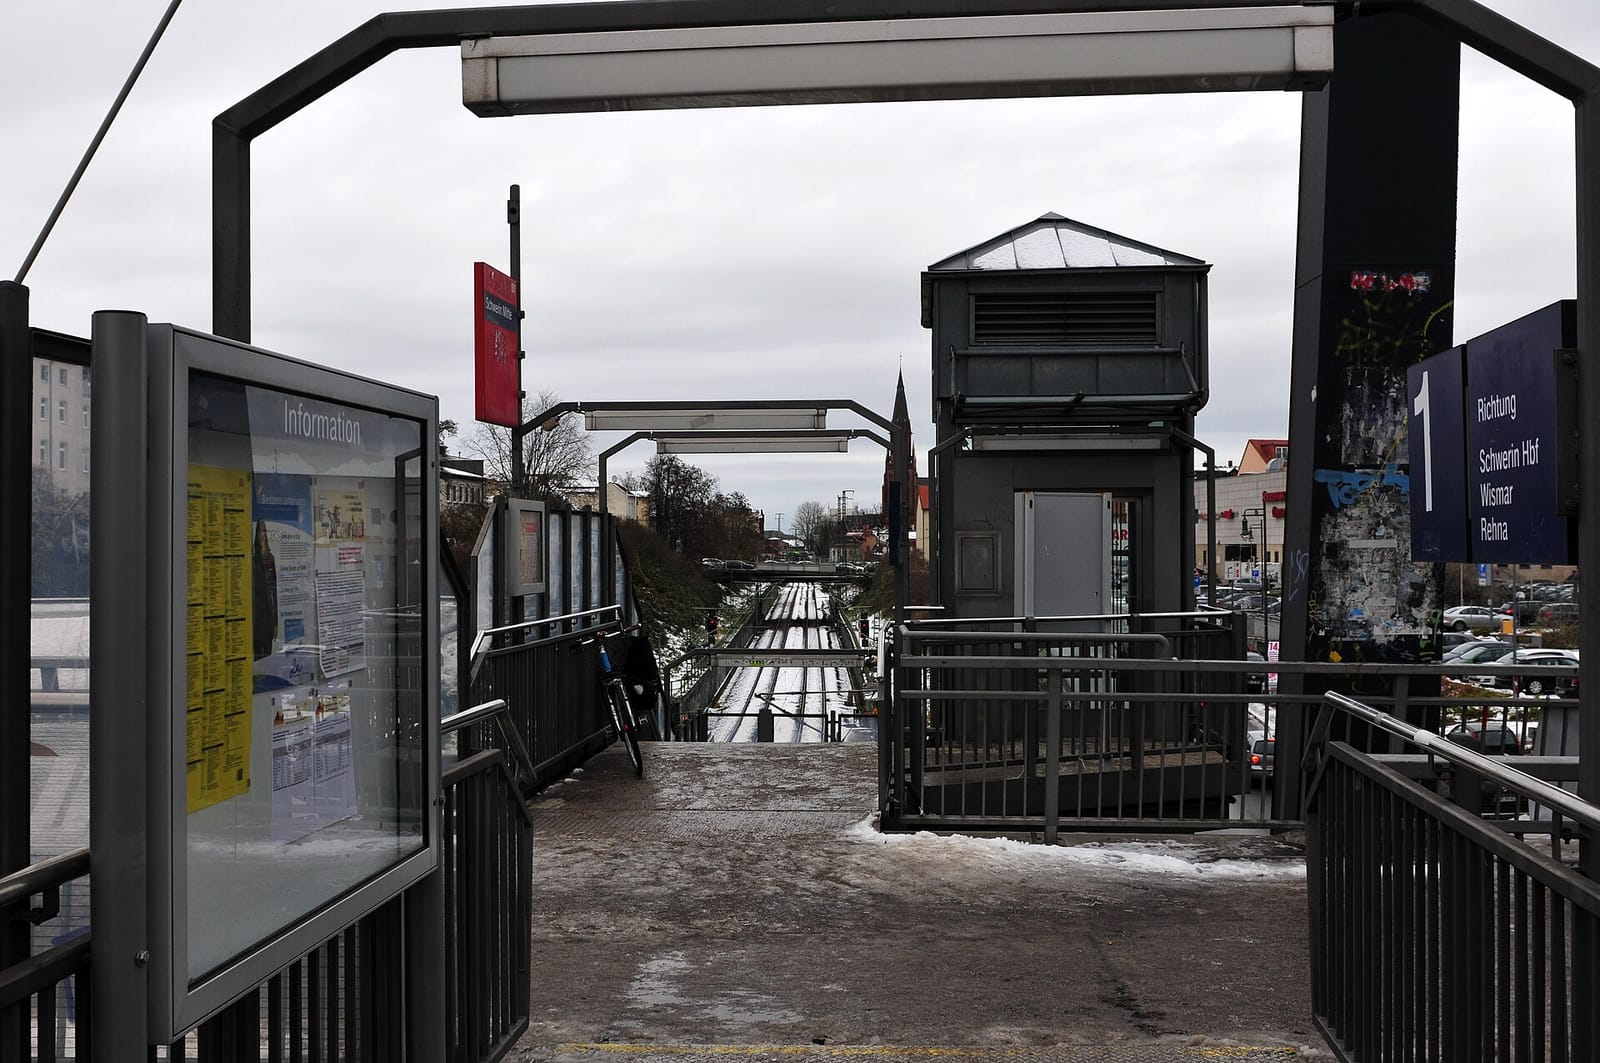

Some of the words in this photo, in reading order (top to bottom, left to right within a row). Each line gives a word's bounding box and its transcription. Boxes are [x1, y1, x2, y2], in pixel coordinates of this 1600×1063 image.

[283, 399, 361, 445] Information
[1477, 393, 1517, 422] Richtung
[1413, 370, 1433, 513] 1
[1479, 443, 1520, 473] Schwerin
[1522, 437, 1540, 466] Hbf
[1480, 483, 1514, 507] Wismar
[1480, 517, 1509, 541] Rehna
